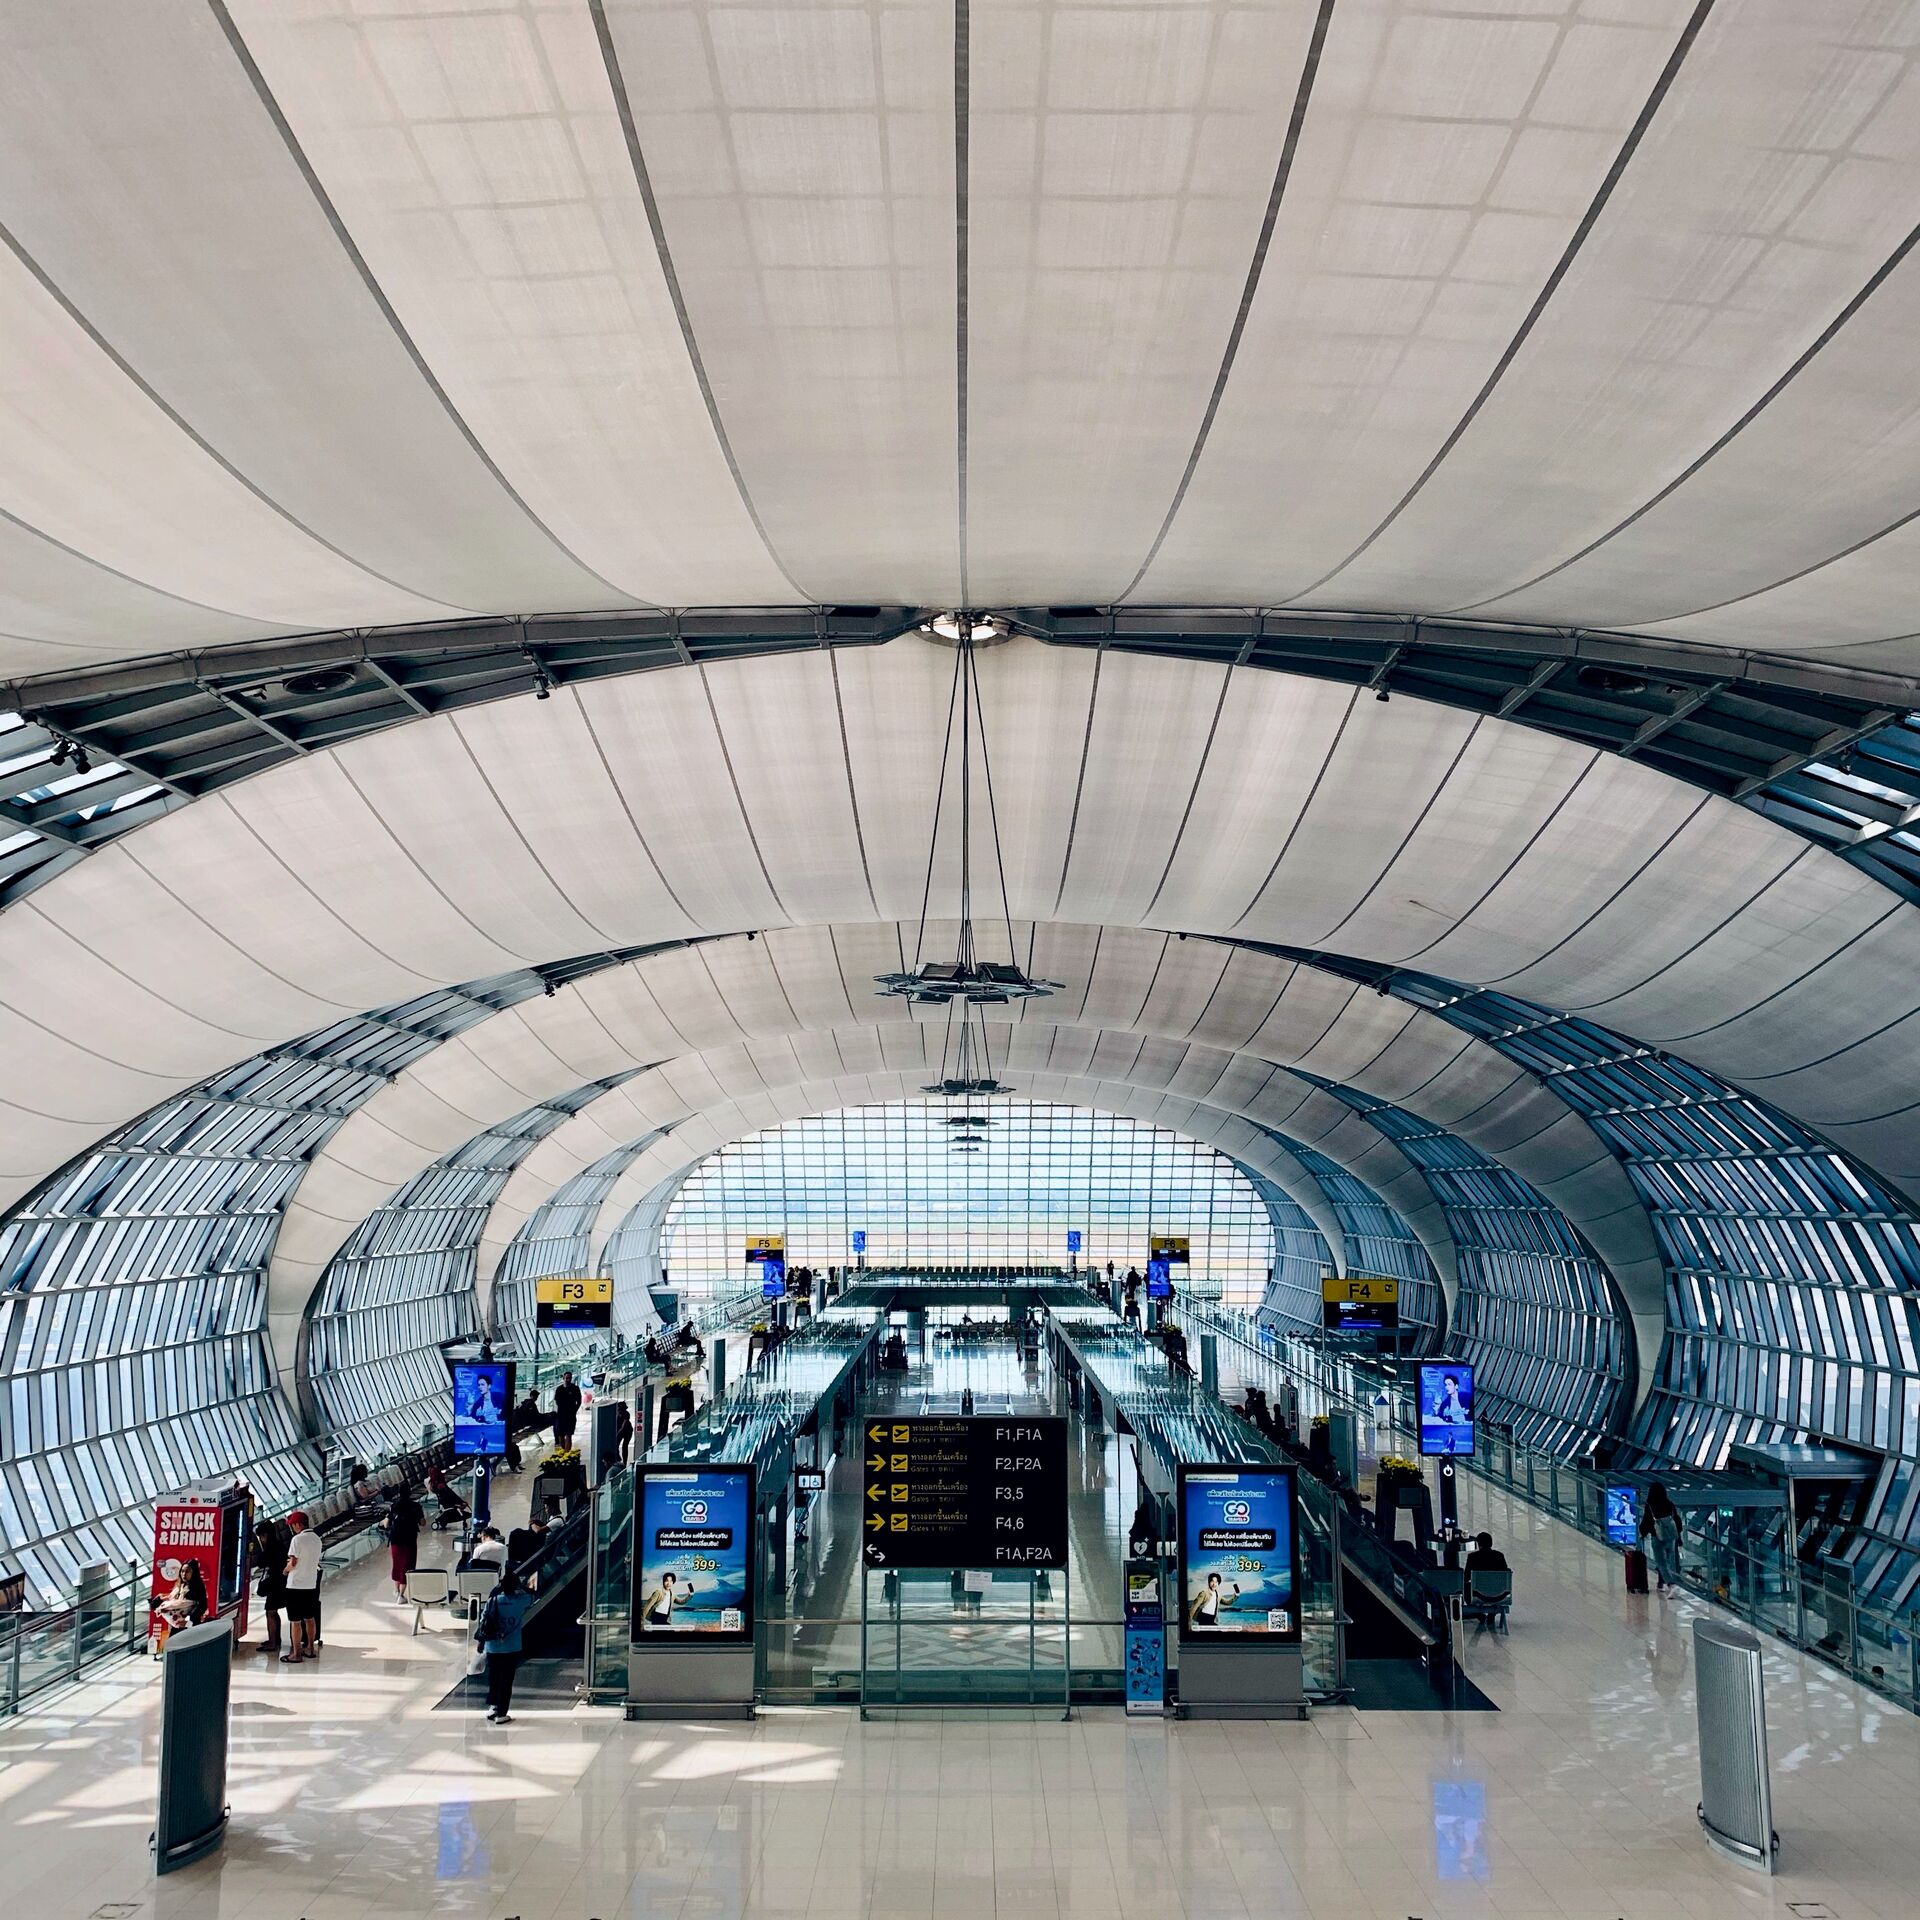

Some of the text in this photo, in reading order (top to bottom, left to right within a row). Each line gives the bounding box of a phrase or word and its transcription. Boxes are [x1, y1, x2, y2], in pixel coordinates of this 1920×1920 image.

[758, 1239, 771, 1248] F5
[1164, 1239, 1176, 1249] F6
[562, 1283, 584, 1299] F3
[1349, 1283, 1371, 1299] F4
[996, 1428, 1043, 1443] F1,F1A
[995, 1457, 1042, 1472] F2,F2A
[995, 1487, 1025, 1501] F3,5
[684, 1502, 706, 1515] GO
[1225, 1502, 1248, 1516] GO
[161, 1511, 216, 1530] SNACK
[995, 1516, 1025, 1531] F4,6
[996, 1547, 1053, 1562] F1A,F2A
[1142, 1606, 1161, 1615] AED
